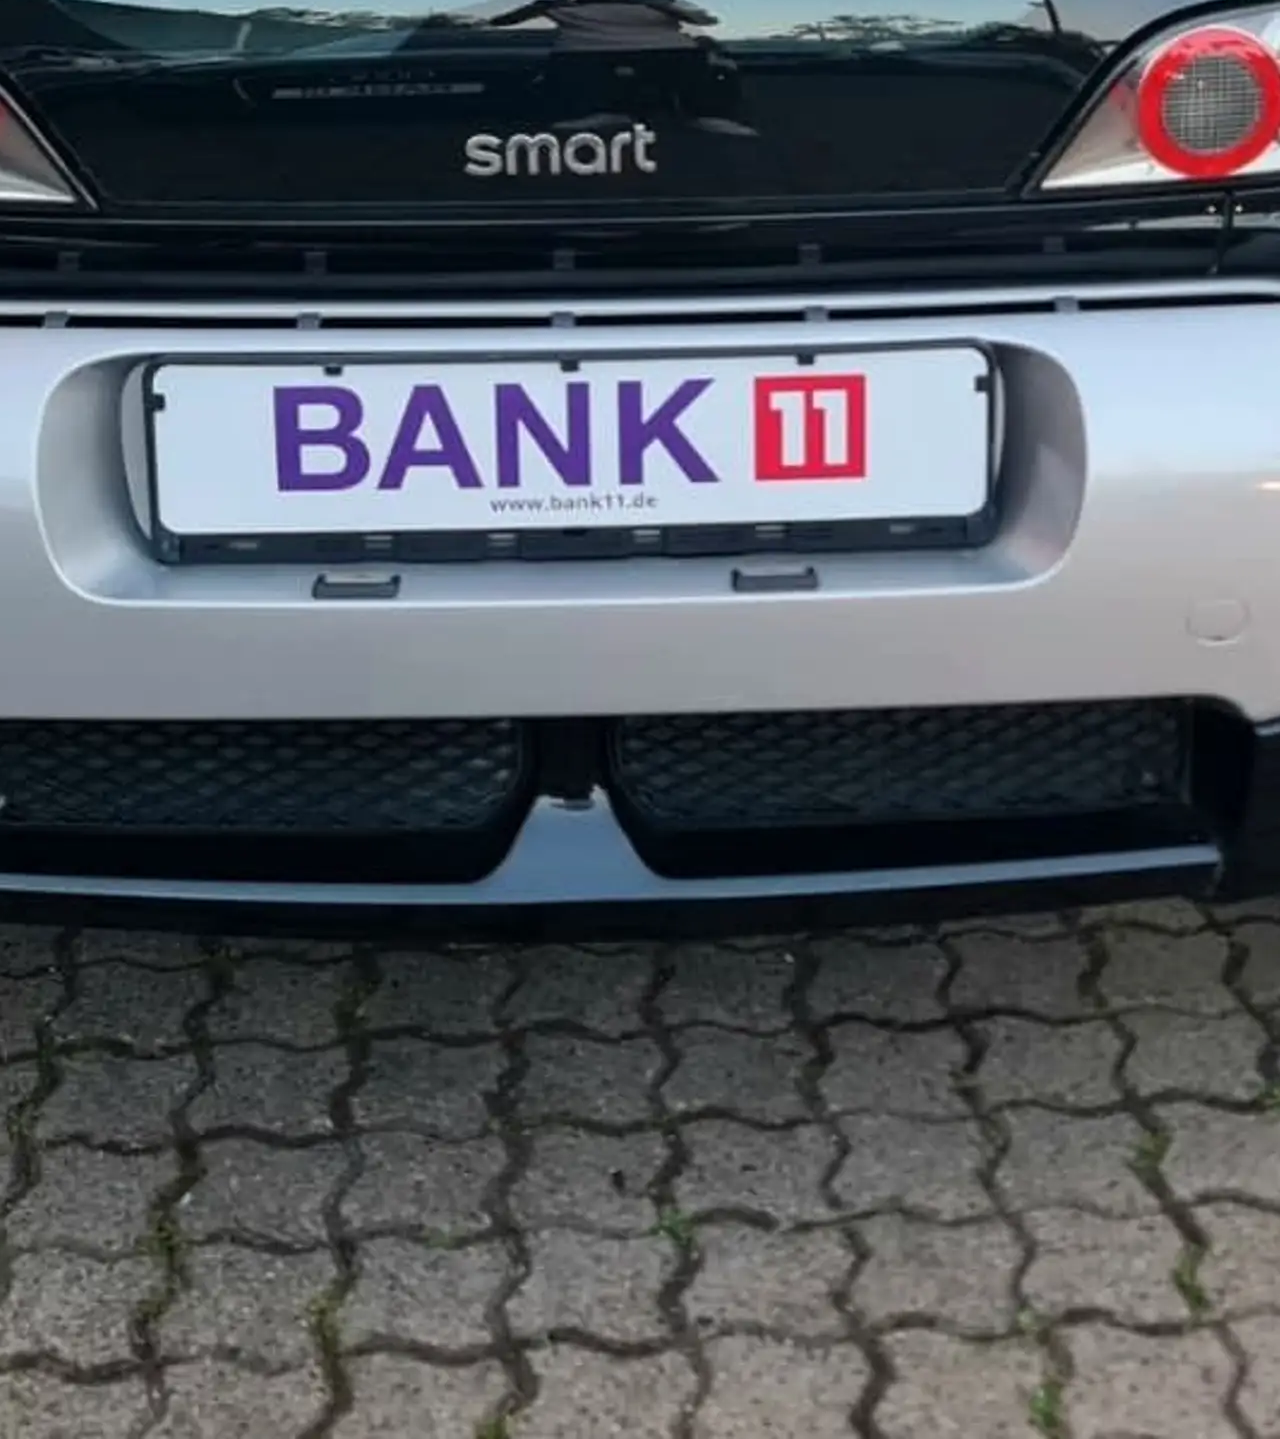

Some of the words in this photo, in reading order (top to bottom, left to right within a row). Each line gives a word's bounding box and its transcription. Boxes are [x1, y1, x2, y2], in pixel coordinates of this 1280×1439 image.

[464, 123, 657, 176] smart
[272, 377, 720, 492] BANK
[764, 384, 858, 472] 11
[489, 492, 659, 513] www.bank11.de
